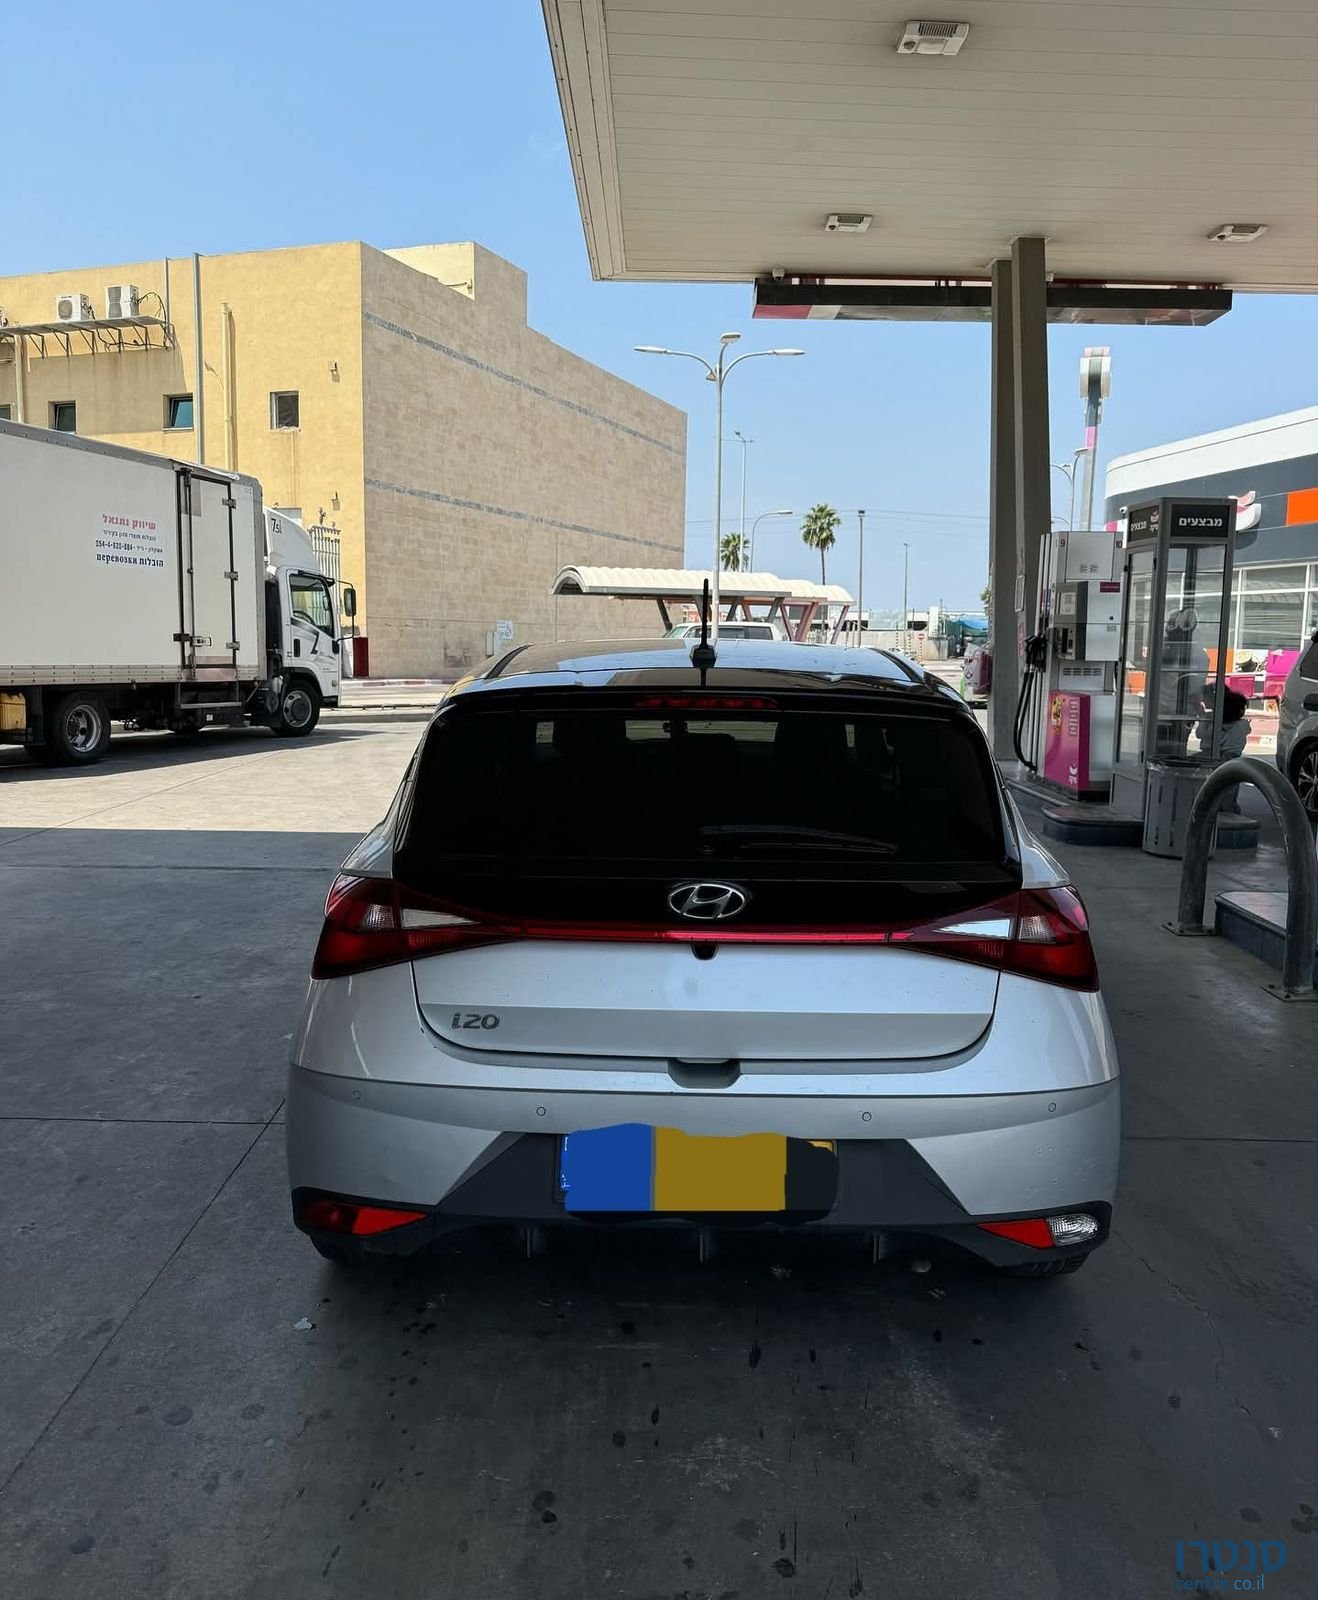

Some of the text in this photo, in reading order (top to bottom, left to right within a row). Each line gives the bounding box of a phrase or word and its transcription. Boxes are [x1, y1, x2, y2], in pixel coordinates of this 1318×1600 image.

[132, 519, 156, 530] שיווק
[1178, 517, 1223, 527] מבצעים
[96, 553, 164, 568] הובלות перевозки
[451, 1012, 500, 1030] i20
